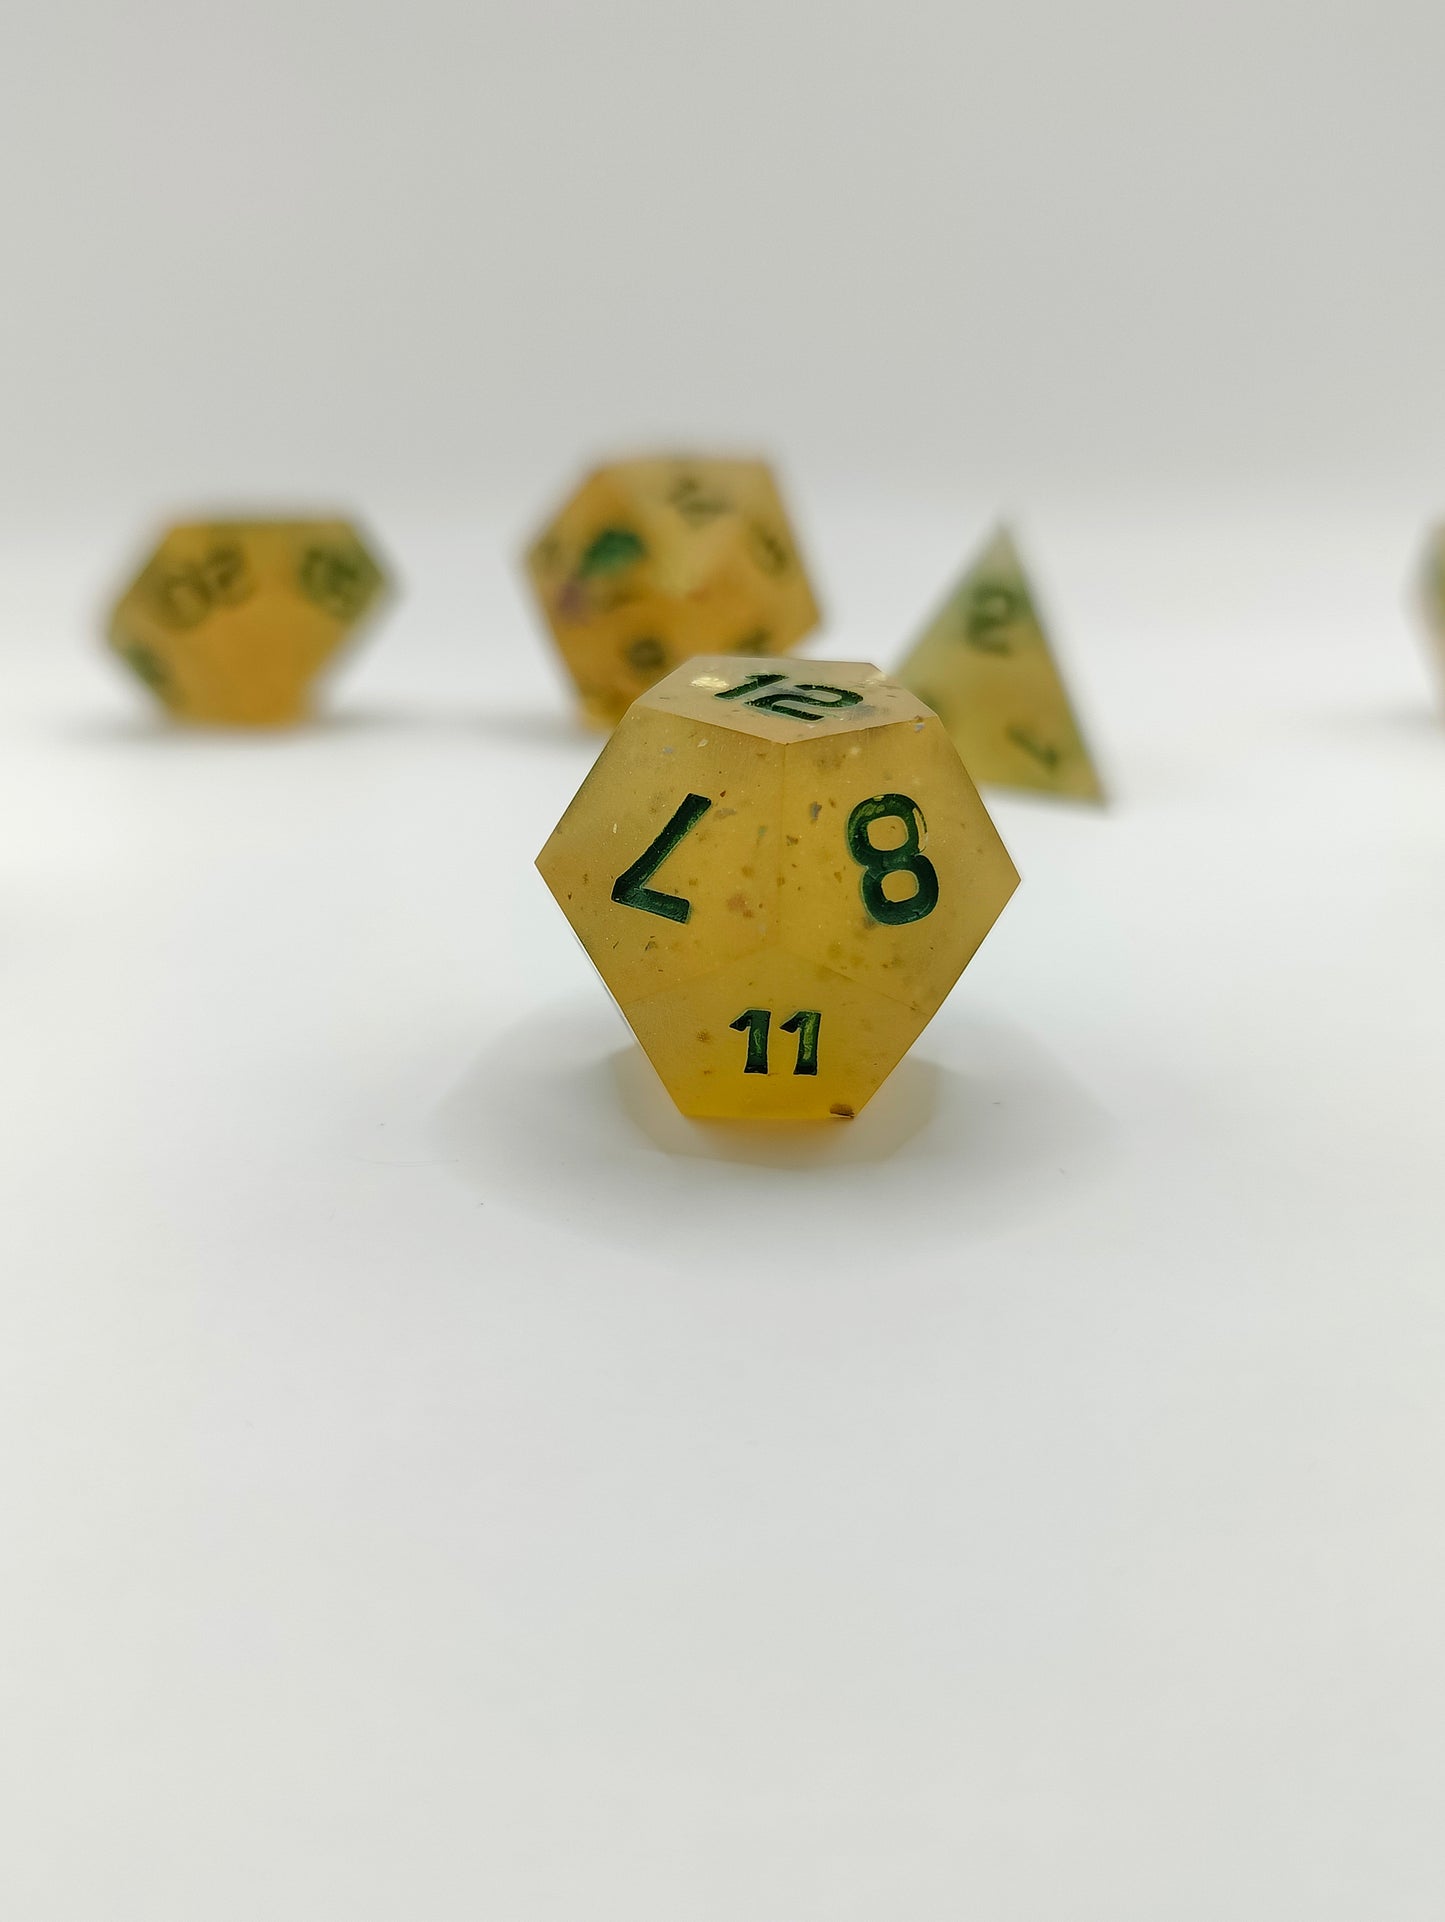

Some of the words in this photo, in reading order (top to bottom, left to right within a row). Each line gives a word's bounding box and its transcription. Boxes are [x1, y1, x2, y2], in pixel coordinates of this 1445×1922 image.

[714, 673, 864, 722] 12
[610, 792, 712, 925] 7
[847, 792, 940, 926] 8
[728, 1008, 822, 1076] 11
